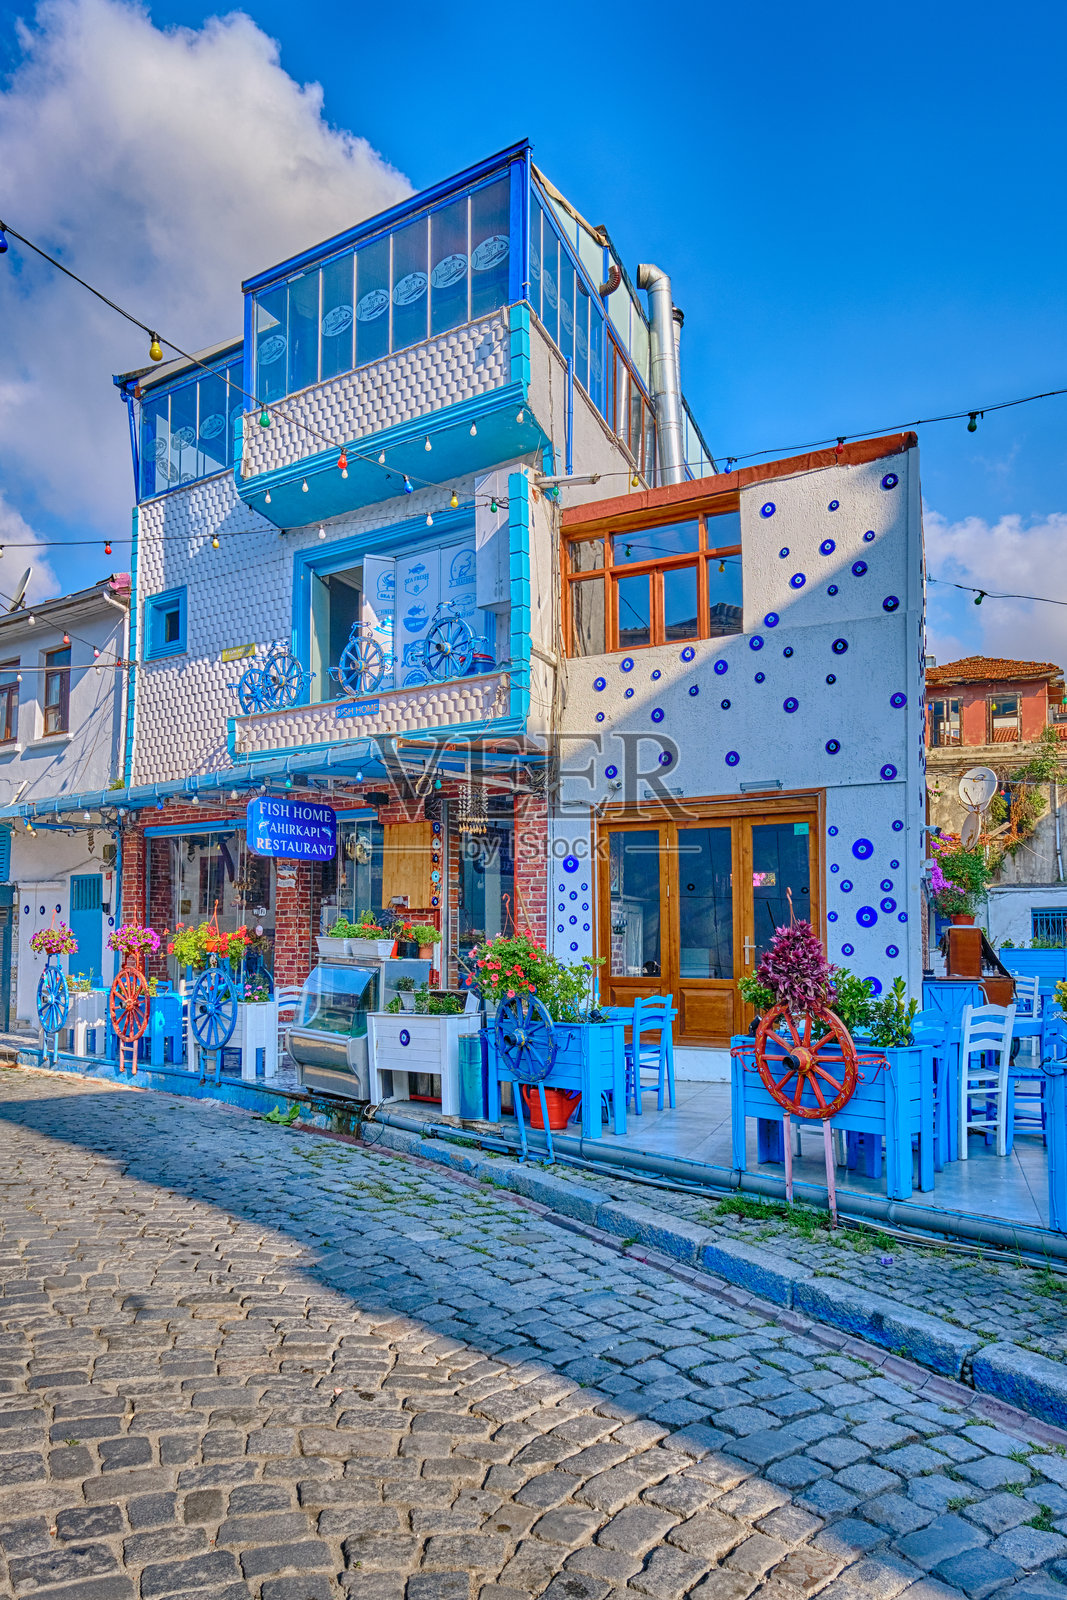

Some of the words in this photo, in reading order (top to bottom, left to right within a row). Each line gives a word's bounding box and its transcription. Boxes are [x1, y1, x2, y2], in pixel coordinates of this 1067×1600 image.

[355, 703, 379, 714] HOME
[259, 801, 290, 817] FISH
[293, 806, 332, 822] HOME
[269, 822, 320, 838] AHIRKAPI
[256, 837, 334, 856] RESTAURANT
